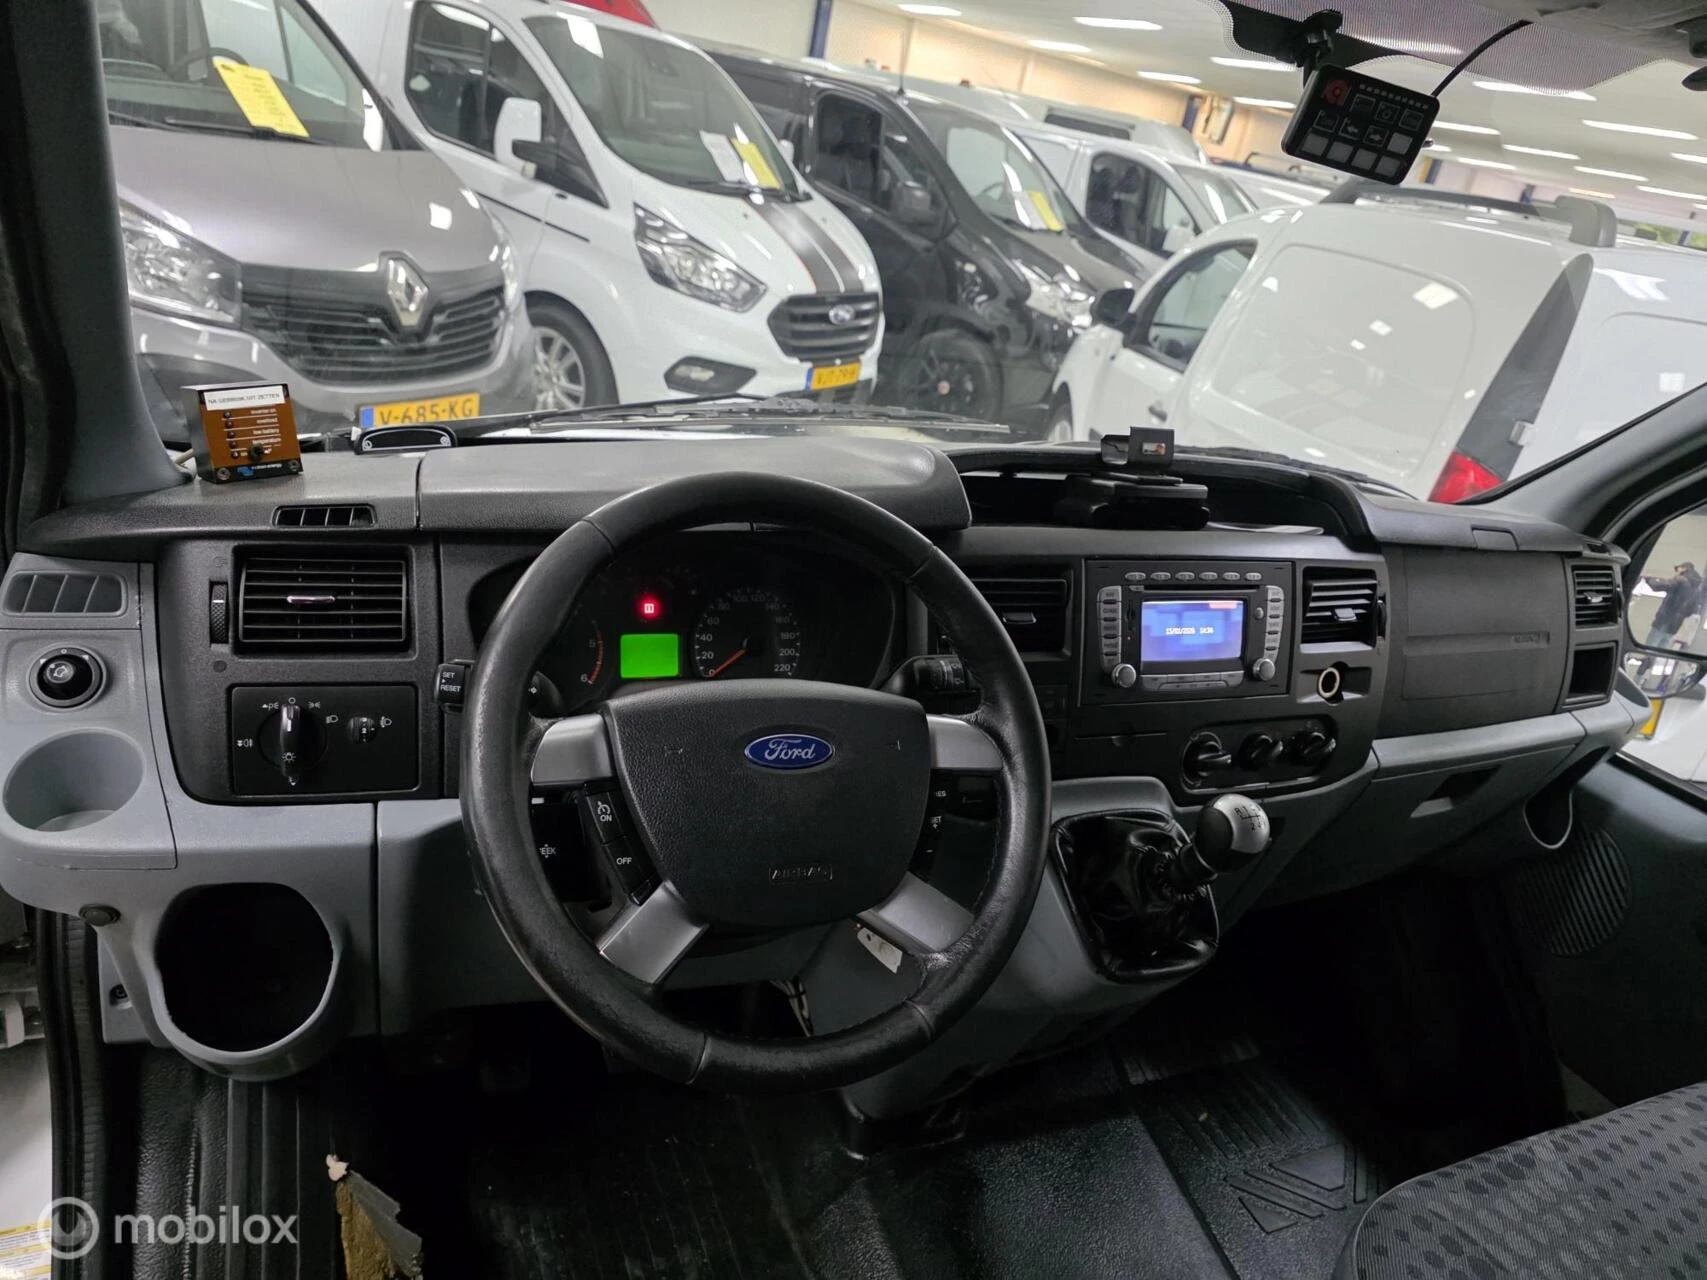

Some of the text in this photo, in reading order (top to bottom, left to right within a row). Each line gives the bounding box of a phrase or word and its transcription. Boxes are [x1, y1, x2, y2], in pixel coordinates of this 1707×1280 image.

[378, 398, 474, 425] V-685-KG
[700, 633, 713, 642] 40
[701, 651, 714, 660] 20
[779, 648, 796, 656] 200
[774, 663, 791, 672] 220
[442, 671, 456, 679] SET
[440, 684, 461, 693] RESET
[764, 738, 816, 760] Ford
[935, 789, 947, 797] ES
[600, 813, 613, 822] ON
[540, 847, 556, 855] EEK
[616, 857, 632, 865] OFF
